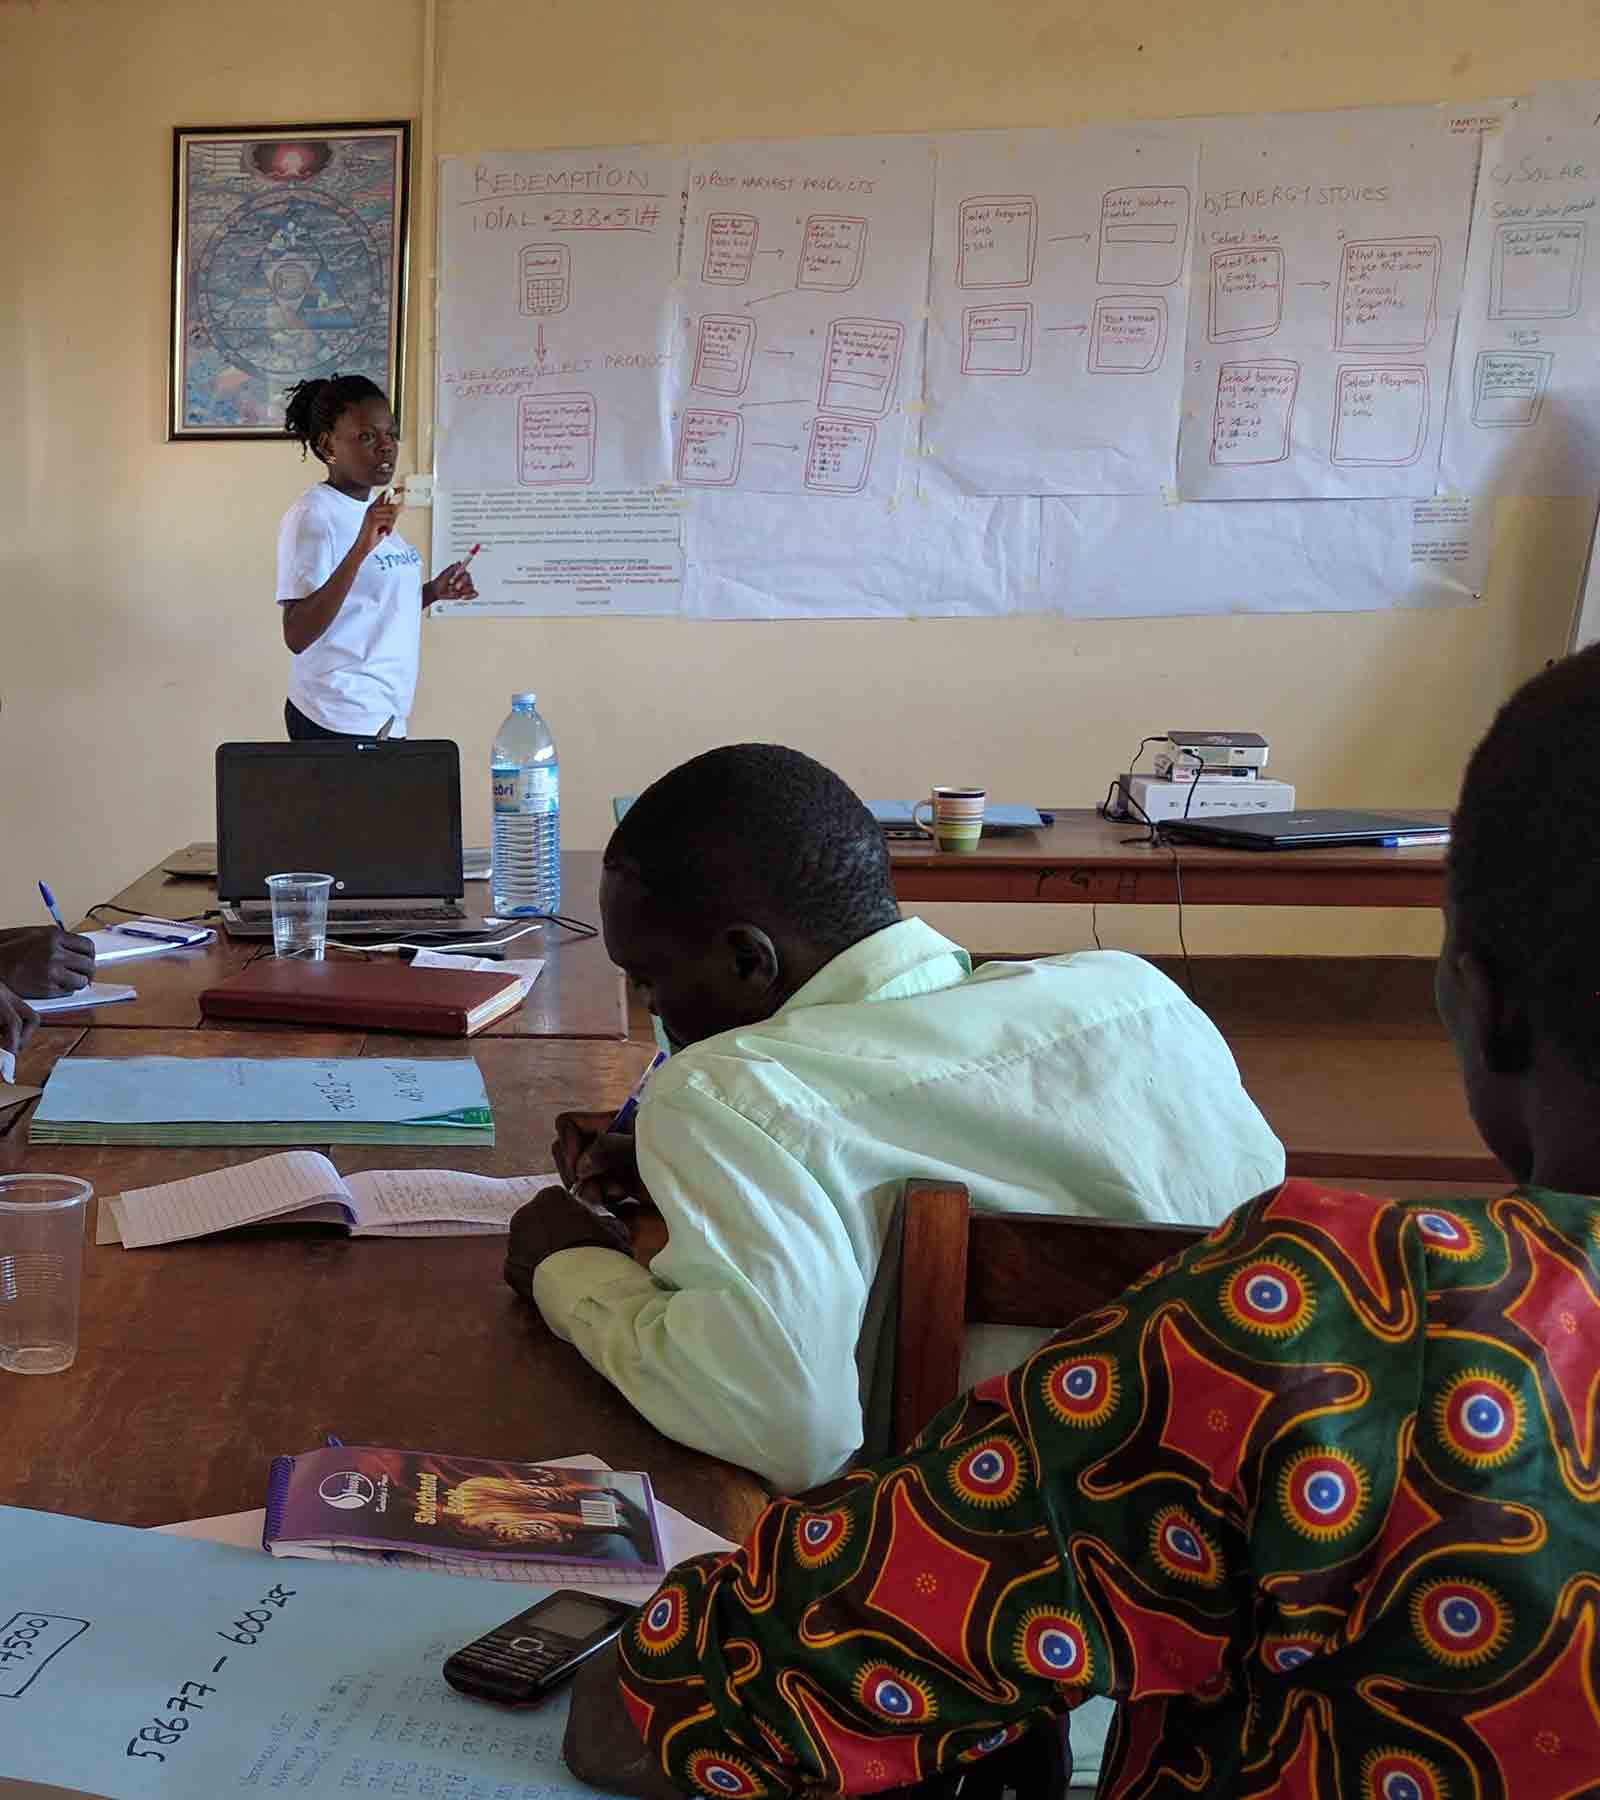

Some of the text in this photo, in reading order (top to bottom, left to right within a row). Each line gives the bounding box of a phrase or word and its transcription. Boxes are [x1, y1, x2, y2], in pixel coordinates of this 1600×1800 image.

[474, 163, 649, 193] REDEMPTION
[1319, 185, 1389, 205] STOVES
[485, 206, 537, 231] DIAL
[414, 1472, 438, 1526] Shorthand
[442, 1488, 465, 1514] Book
[125, 1680, 217, 1763] 58677
[216, 1608, 273, 1646] 600
